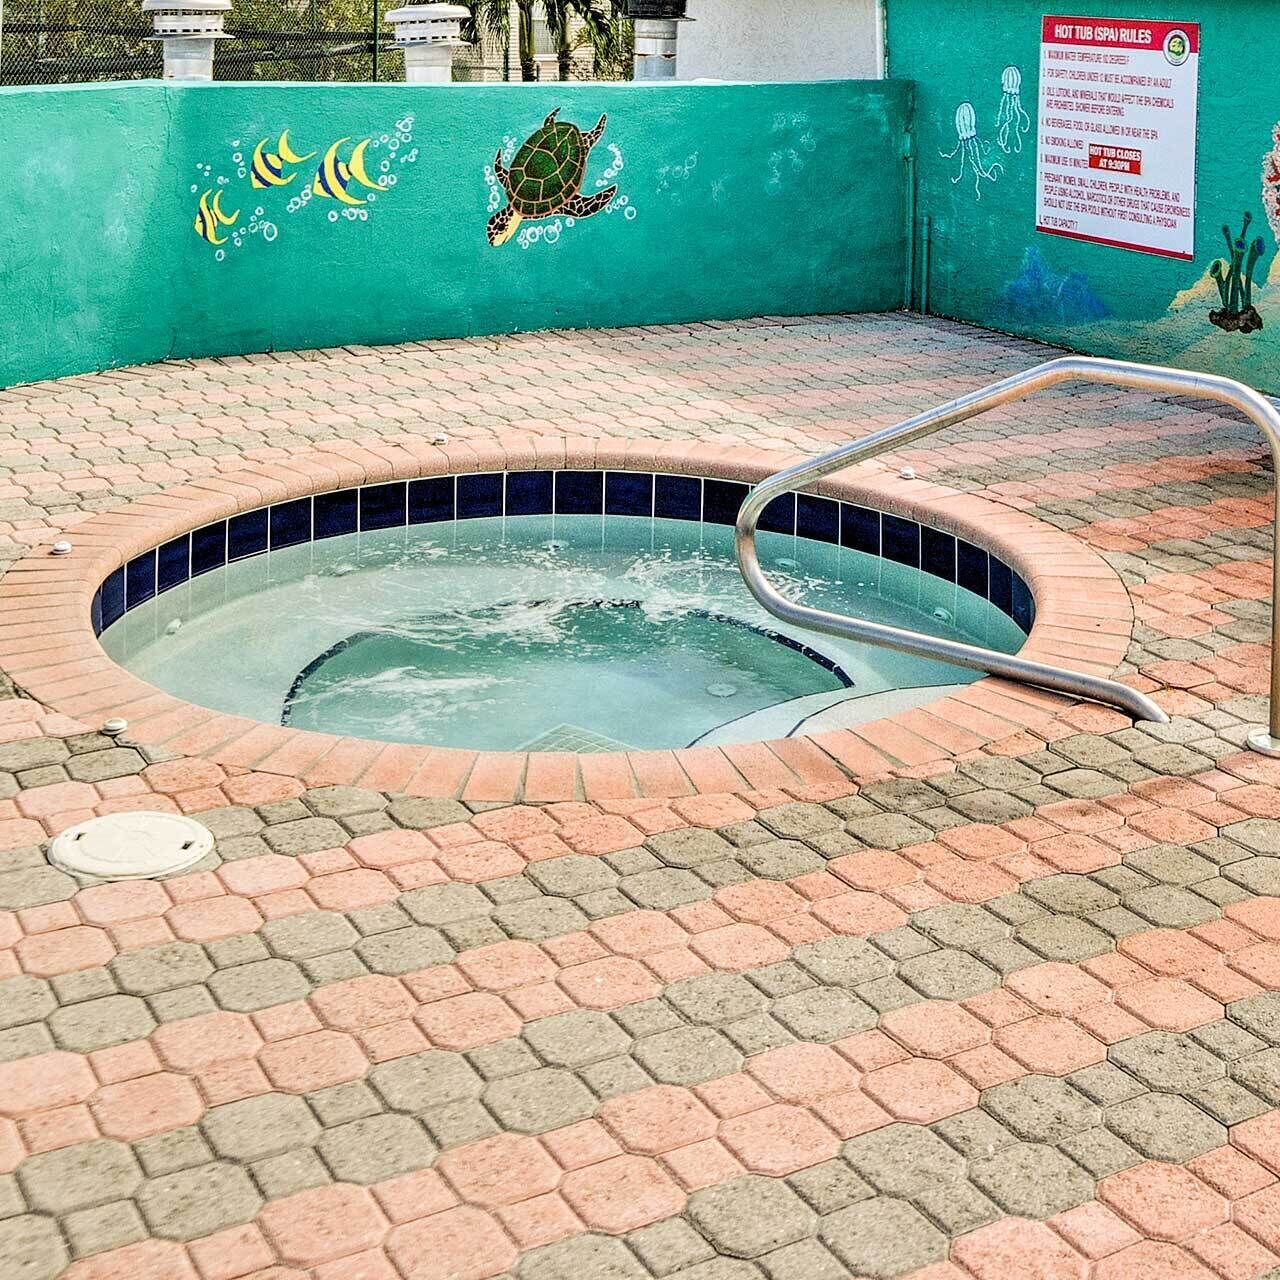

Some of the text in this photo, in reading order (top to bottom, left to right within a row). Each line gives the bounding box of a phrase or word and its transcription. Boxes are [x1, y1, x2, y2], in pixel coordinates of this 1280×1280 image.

[1055, 24, 1152, 44] HOT TUB (SPA) RULES
[1090, 145, 1141, 161] HOT TUB CLOSES
[1100, 158, 1107, 167] AT
